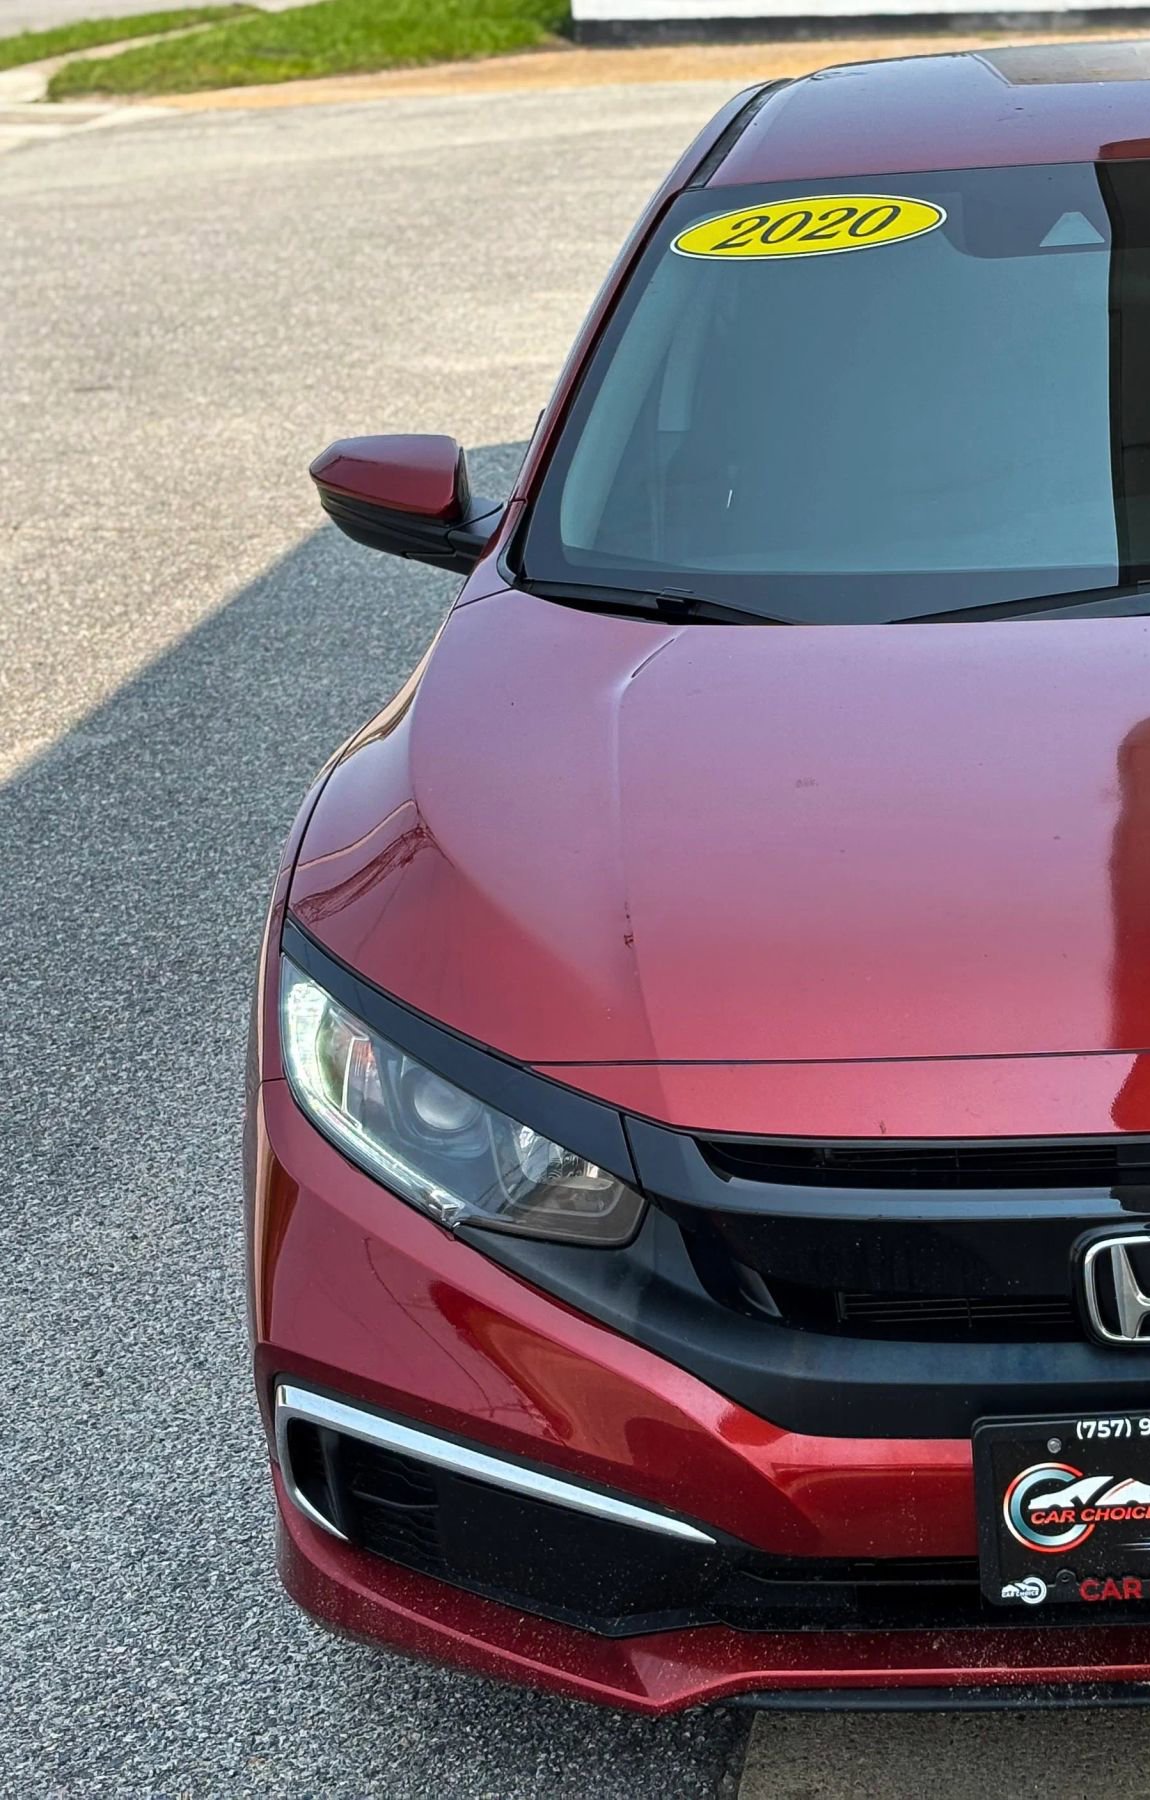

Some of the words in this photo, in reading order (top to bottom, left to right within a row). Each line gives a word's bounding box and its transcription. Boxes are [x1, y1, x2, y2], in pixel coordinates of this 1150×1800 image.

[710, 205, 901, 251] 2020
[1076, 1418, 1132, 1440] (757)
[1031, 1508, 1075, 1525] CAR
[1079, 1577, 1142, 1601] CAR
